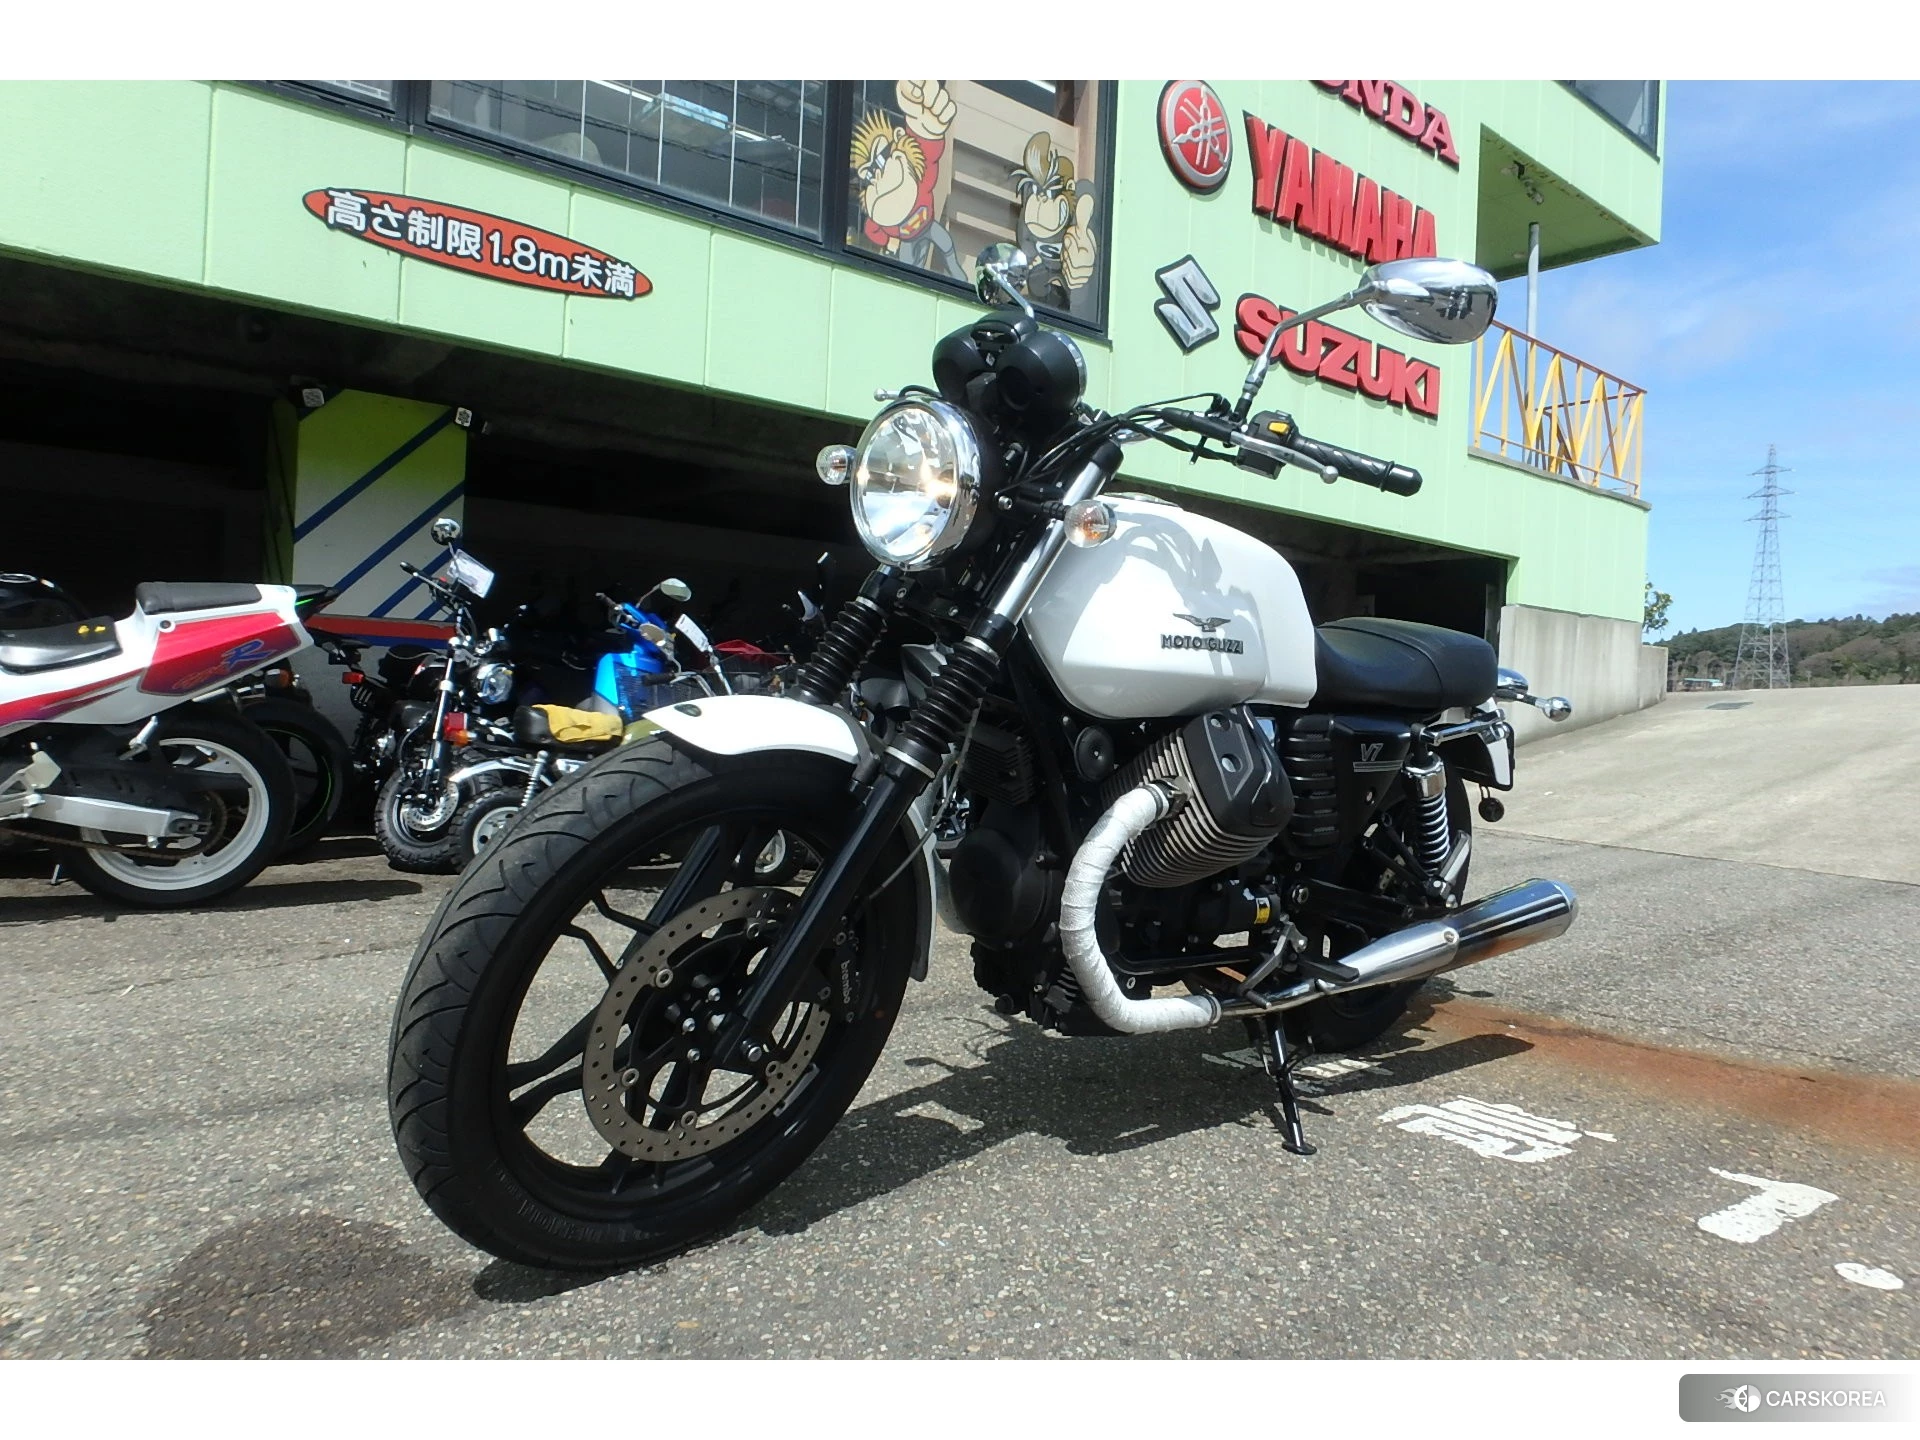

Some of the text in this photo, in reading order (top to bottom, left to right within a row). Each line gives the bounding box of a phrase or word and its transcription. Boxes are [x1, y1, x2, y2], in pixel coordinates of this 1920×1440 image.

[1309, 80, 1459, 170] NDA
[1244, 112, 1437, 263] YAMAHA
[327, 189, 637, 297] 高さ制限1.8m未満
[1235, 295, 1440, 416] SUZUKI
[1161, 633, 1244, 655] MOTO GUZZI
[1360, 742, 1385, 762] V7
[840, 959, 853, 1004] brembo
